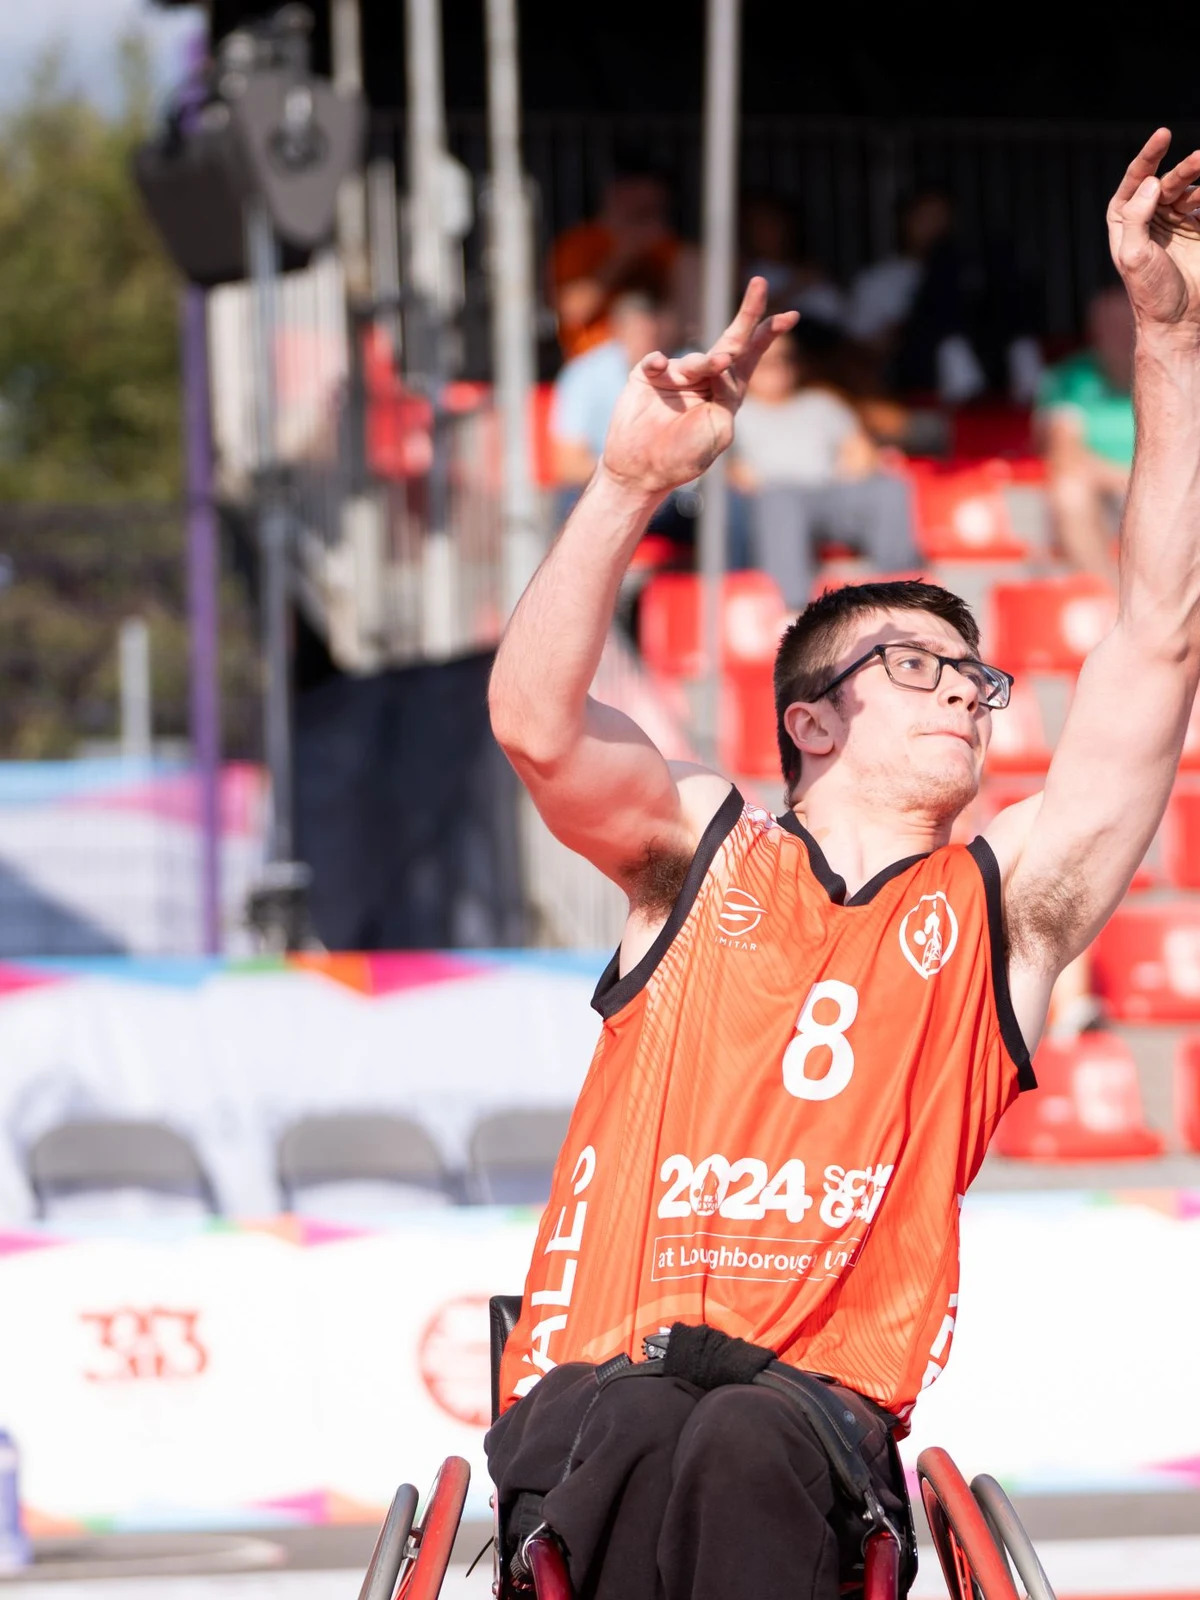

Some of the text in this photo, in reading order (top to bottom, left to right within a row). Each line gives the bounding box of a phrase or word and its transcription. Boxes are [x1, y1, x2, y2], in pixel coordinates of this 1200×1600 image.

[782, 979, 859, 1101] 8
[657, 1154, 813, 1223] 2024
[658, 1247, 675, 1268] at
